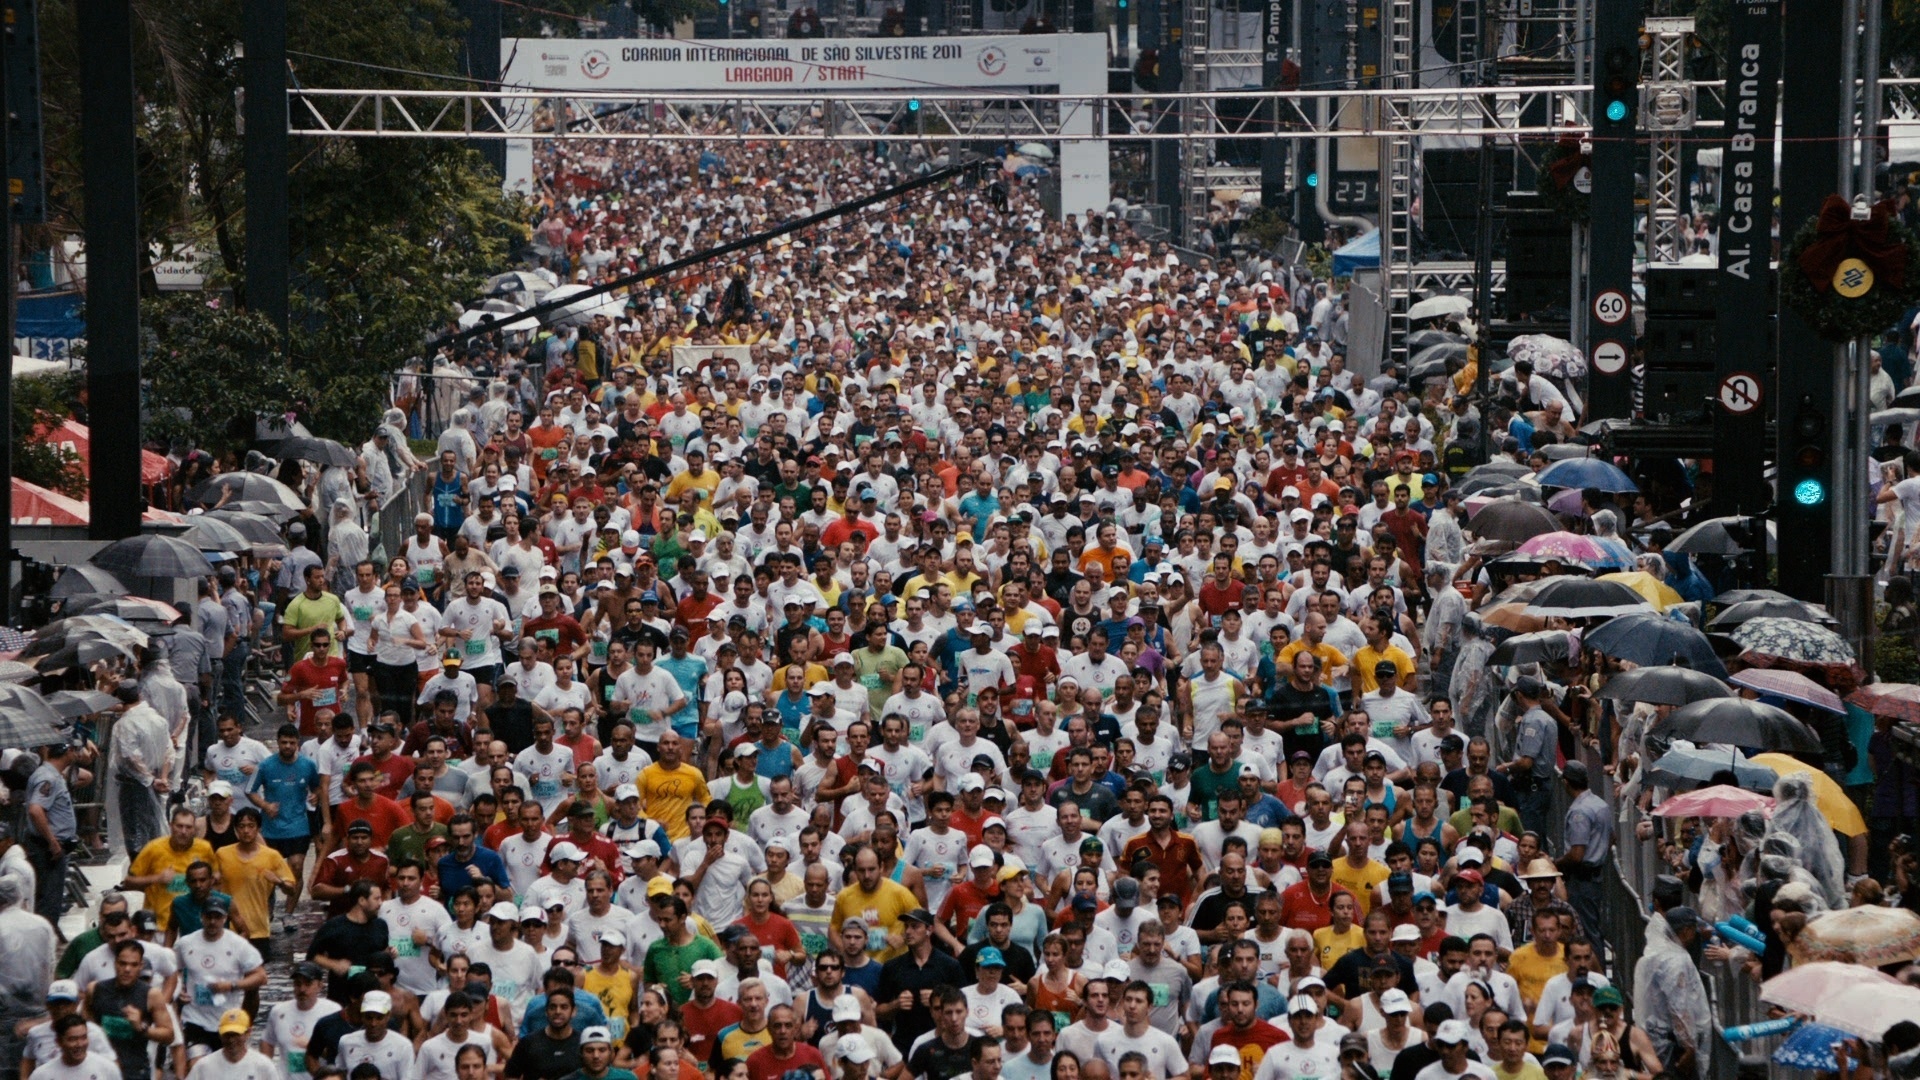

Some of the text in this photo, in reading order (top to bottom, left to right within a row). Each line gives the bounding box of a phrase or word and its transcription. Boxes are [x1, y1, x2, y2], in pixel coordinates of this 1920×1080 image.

[1748, 6, 1767, 15] rua
[622, 44, 962, 62] CORRIDA INTERNACIONAL DE SÃO SILVESTRE 2011
[1266, 48, 1278, 62] R.
[725, 66, 793, 83] LARGADA
[818, 65, 867, 82] START
[1726, 44, 1760, 280] Al. Casa Branca
[155, 266, 192, 275] Cidade
[1599, 298, 1623, 313] 60
